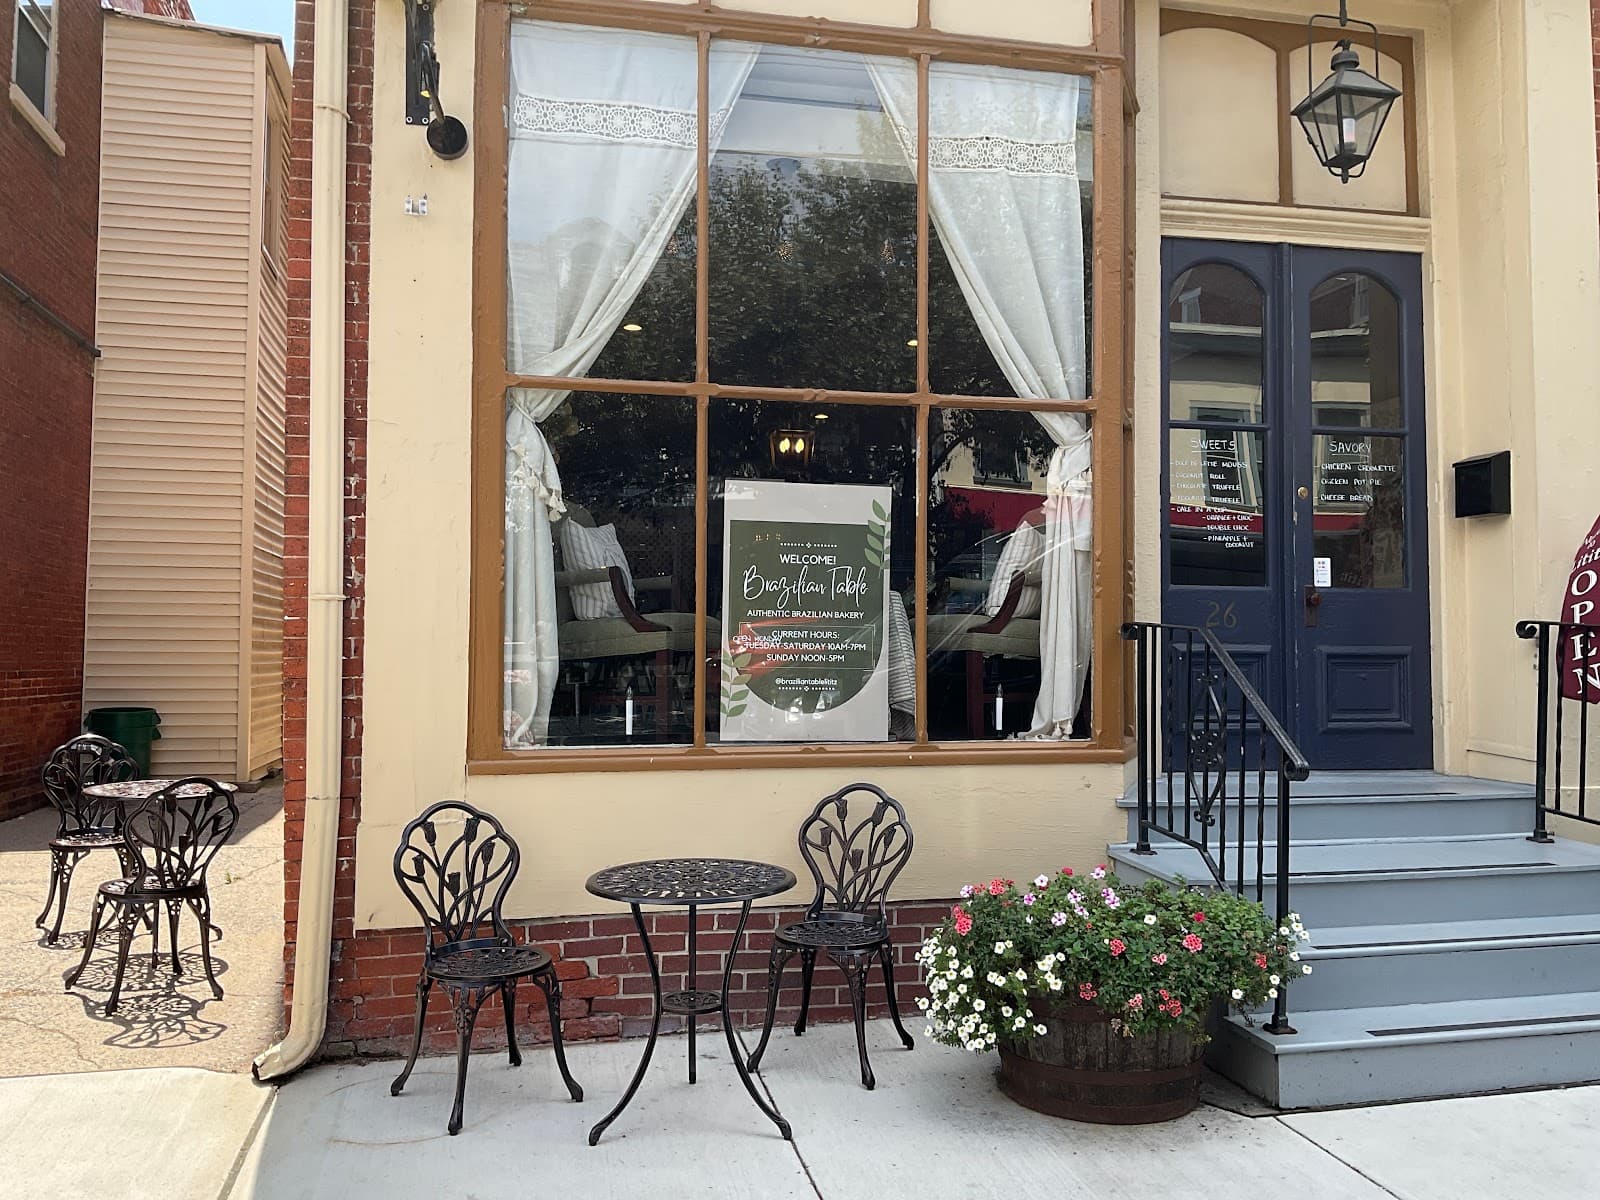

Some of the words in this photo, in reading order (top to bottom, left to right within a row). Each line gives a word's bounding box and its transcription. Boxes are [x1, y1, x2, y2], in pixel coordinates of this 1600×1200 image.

[1191, 439, 1236, 450] SWEETS
[1329, 441, 1371, 453] SAVORY
[1353, 478, 1365, 486] POT
[1349, 494, 1373, 502] BREAD
[779, 554, 837, 565] WELCOME!
[743, 565, 827, 609] Brazilian
[826, 565, 869, 608] Table
[746, 609, 790, 618] AUTHENTIC
[791, 610, 833, 619] BRAZILIAN
[834, 612, 865, 620] BAKERY
[1206, 601, 1237, 628] 26
[771, 630, 809, 640] CURRENT
[809, 631, 840, 640] HOURS:
[827, 643, 867, 652] 10AM-7PM
[766, 653, 799, 662] SUNDAY
[800, 654, 846, 662] NOON-5PM
[775, 677, 838, 686] @braziliantablelititz
